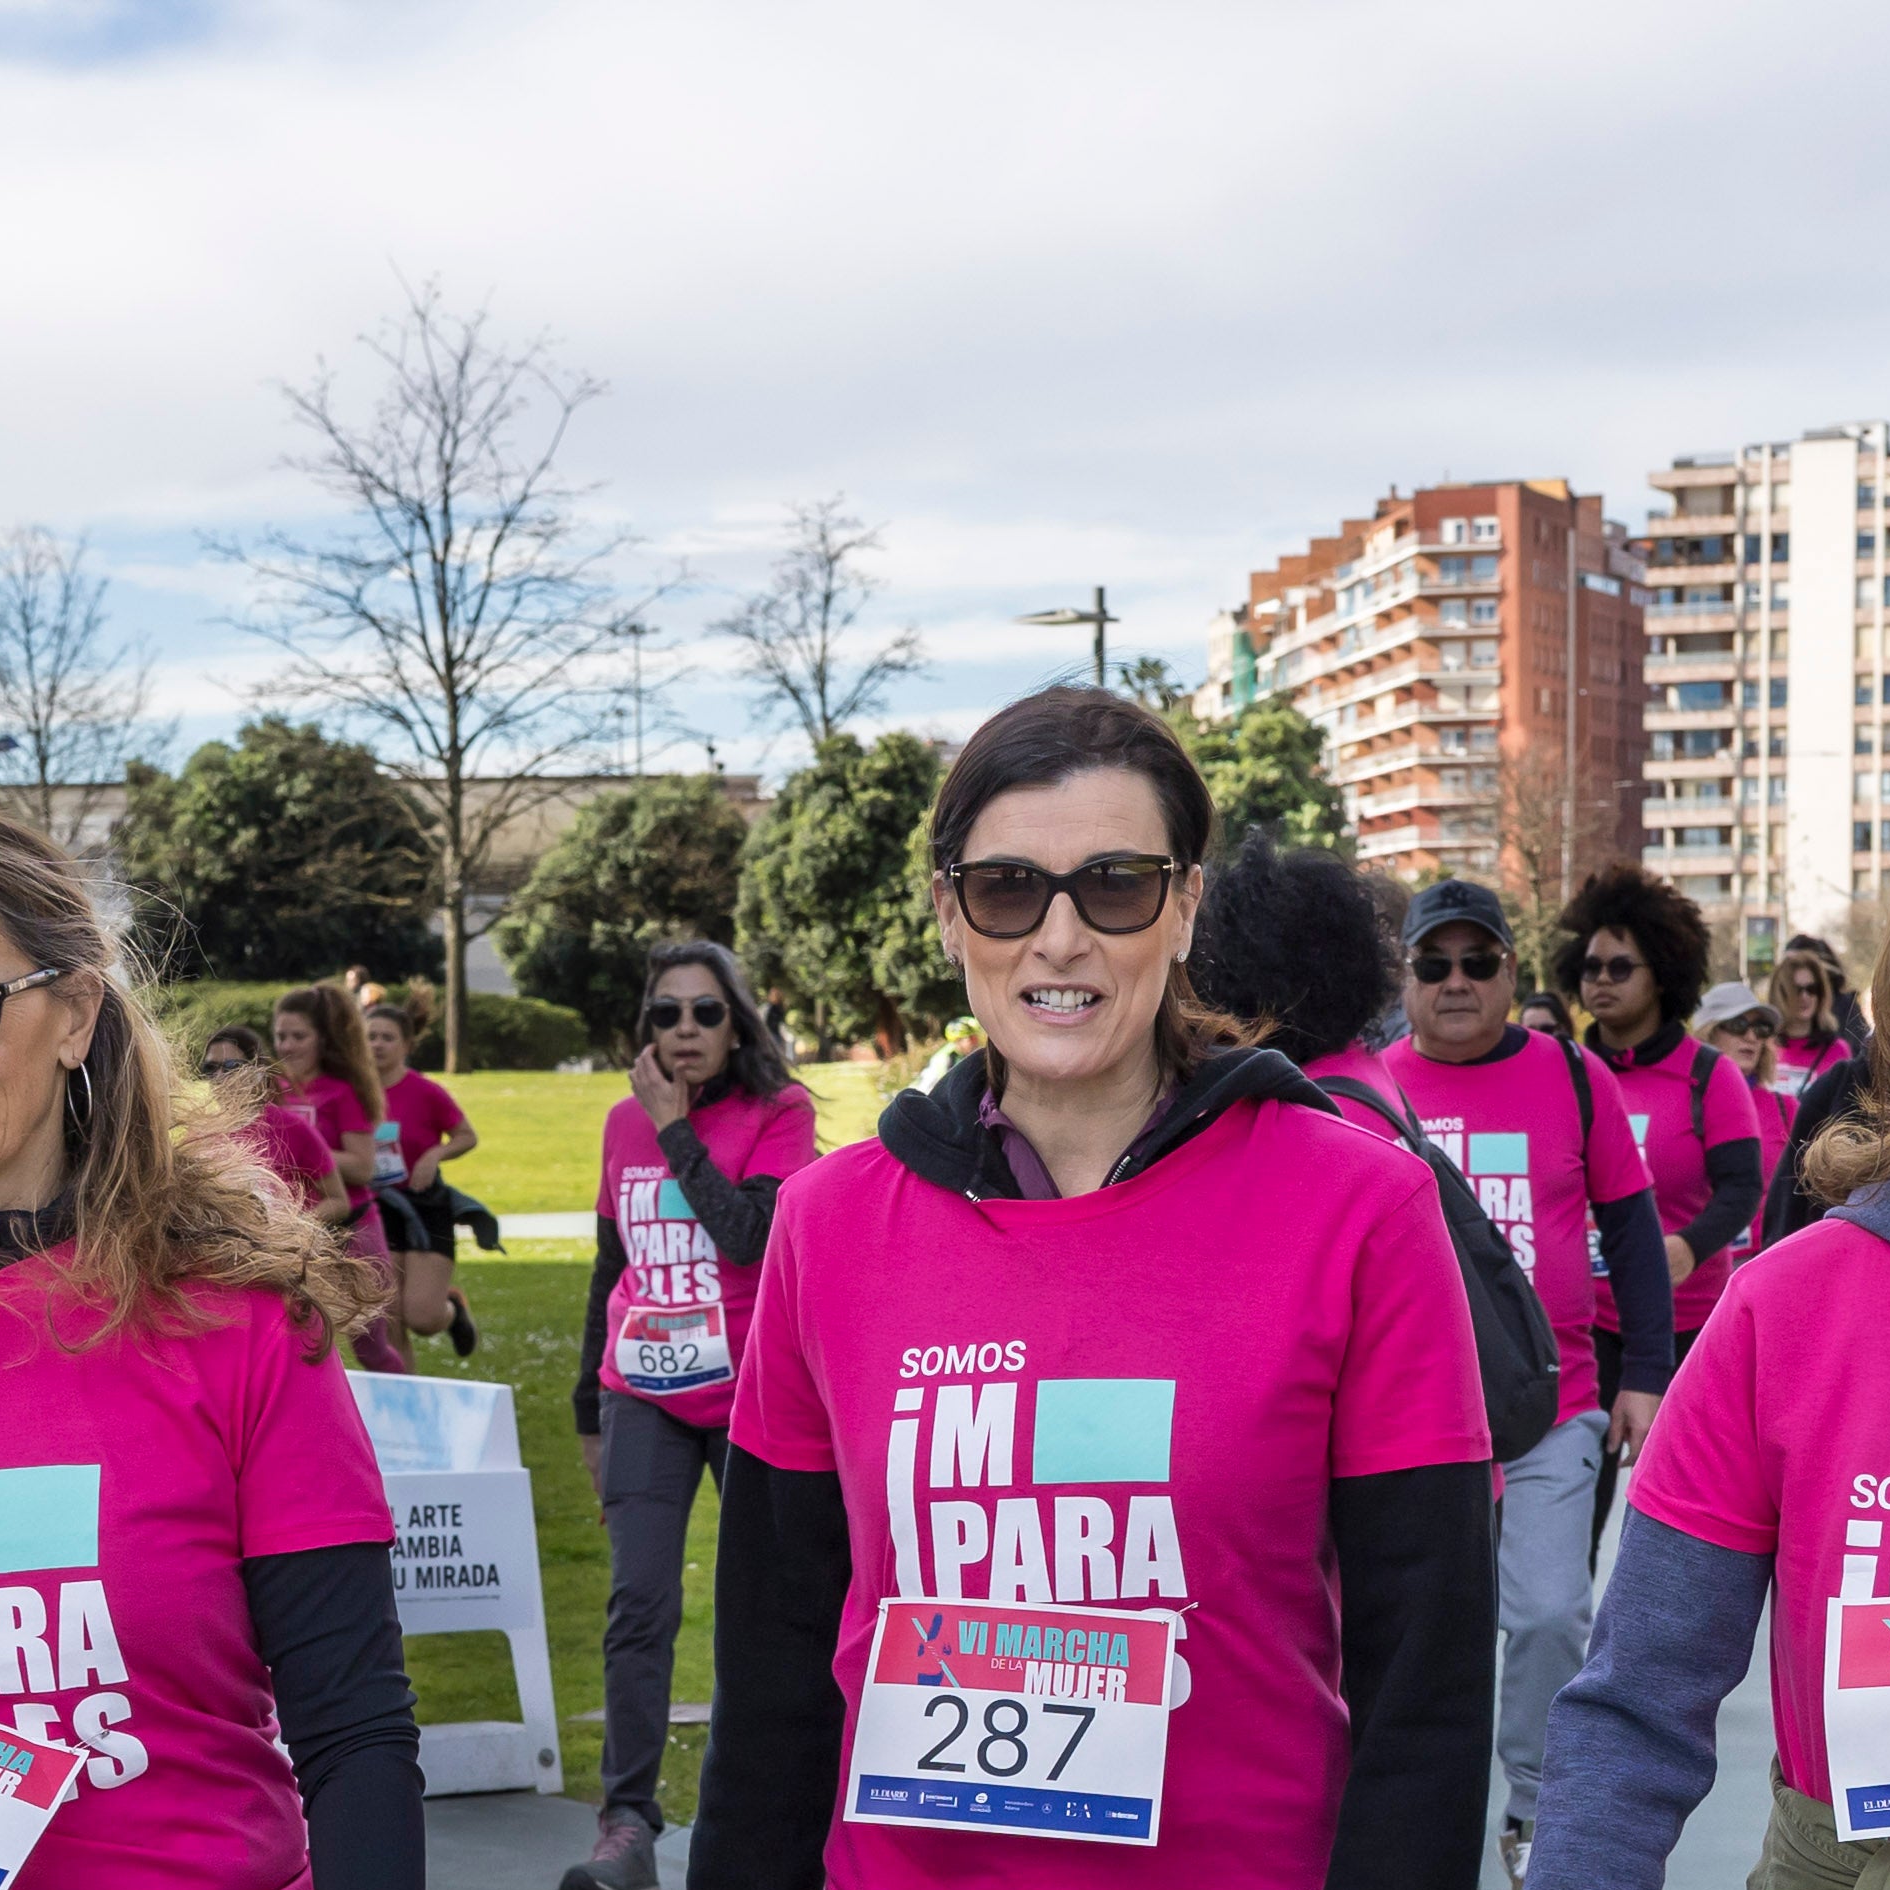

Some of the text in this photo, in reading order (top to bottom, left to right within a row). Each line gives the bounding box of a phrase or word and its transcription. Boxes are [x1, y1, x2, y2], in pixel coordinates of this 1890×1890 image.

[630, 1222, 718, 1267] PARA
[638, 1343, 704, 1374] 682
[899, 1340, 1027, 1379] SOMOS
[408, 1504, 463, 1528] ARTE
[393, 1535, 463, 1559] AMBIA
[929, 1495, 1188, 1603] PARA
[394, 1564, 500, 1590] U MIRADA
[958, 1620, 1130, 1668] VI MARCHA
[990, 1658, 1127, 1703] DE LA MUJER
[917, 1693, 1097, 1781] 287
